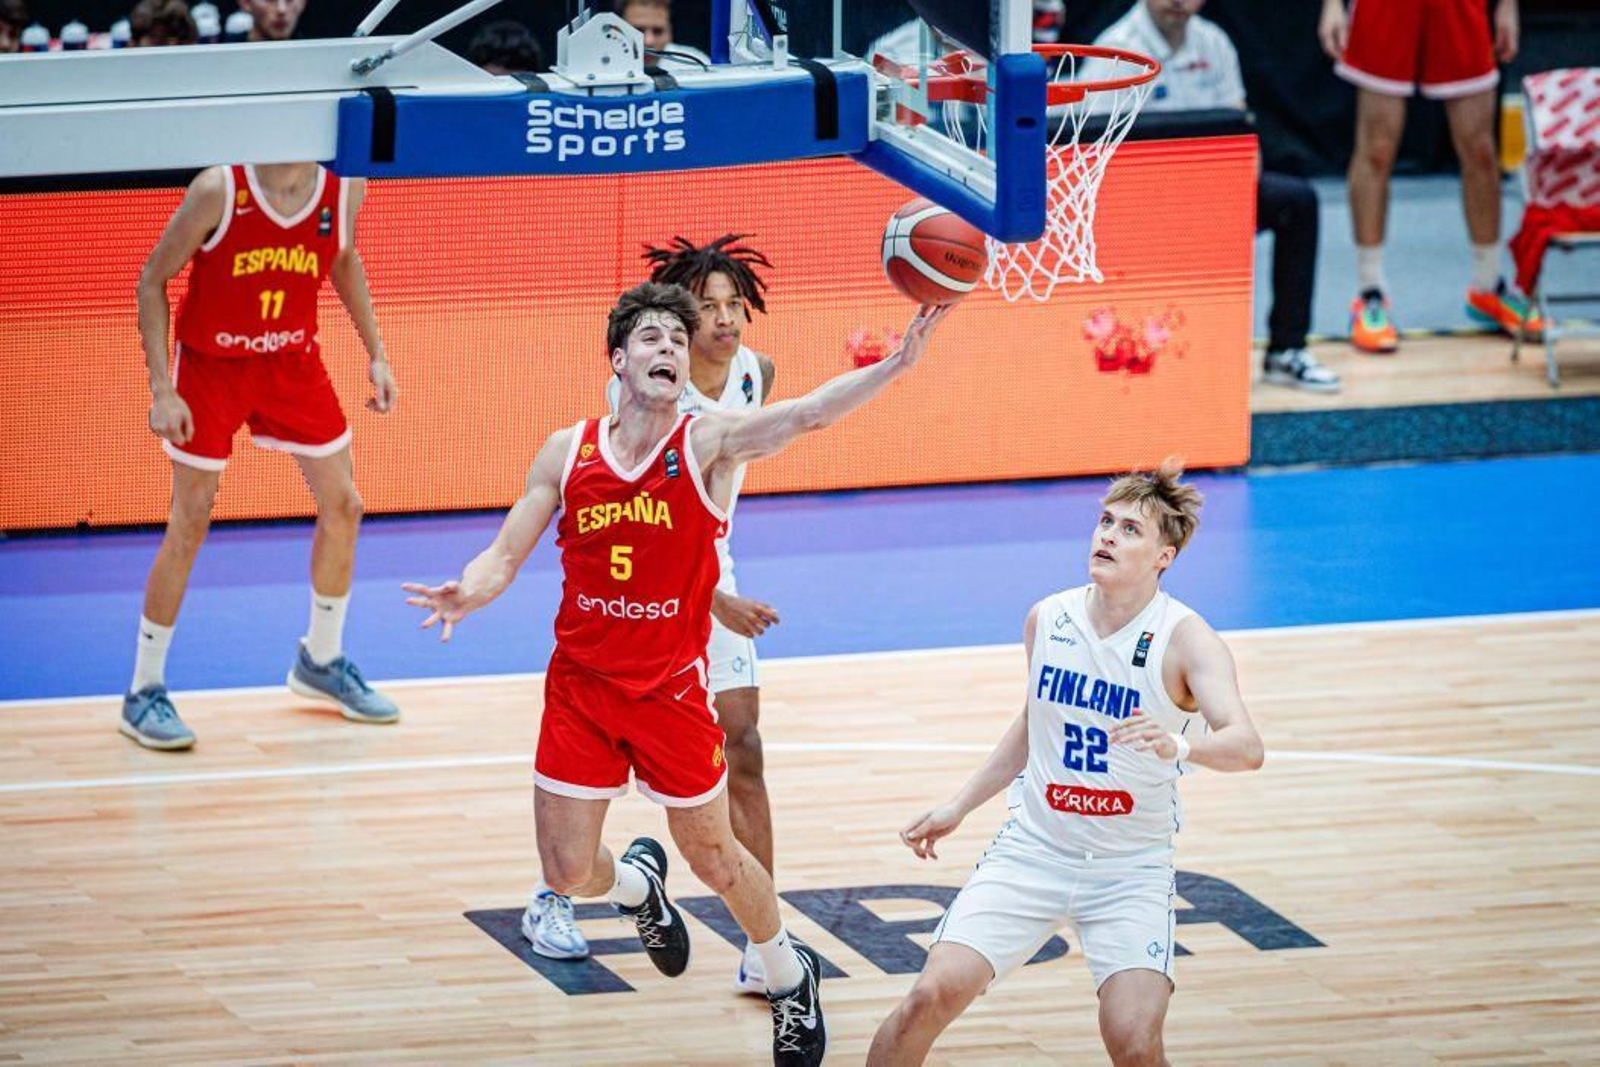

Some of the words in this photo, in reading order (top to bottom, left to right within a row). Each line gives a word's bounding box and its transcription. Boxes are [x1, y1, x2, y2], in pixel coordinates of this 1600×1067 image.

[527, 99, 685, 130] Schelde
[526, 127, 686, 161] Sports
[232, 244, 319, 278] ESPAÑA
[259, 290, 286, 320] 11
[576, 491, 674, 535] ESPAÑA
[609, 545, 634, 581] 5
[577, 593, 680, 620] endesa
[1036, 664, 1141, 720] FINLAND
[1063, 722, 1108, 774] 22
